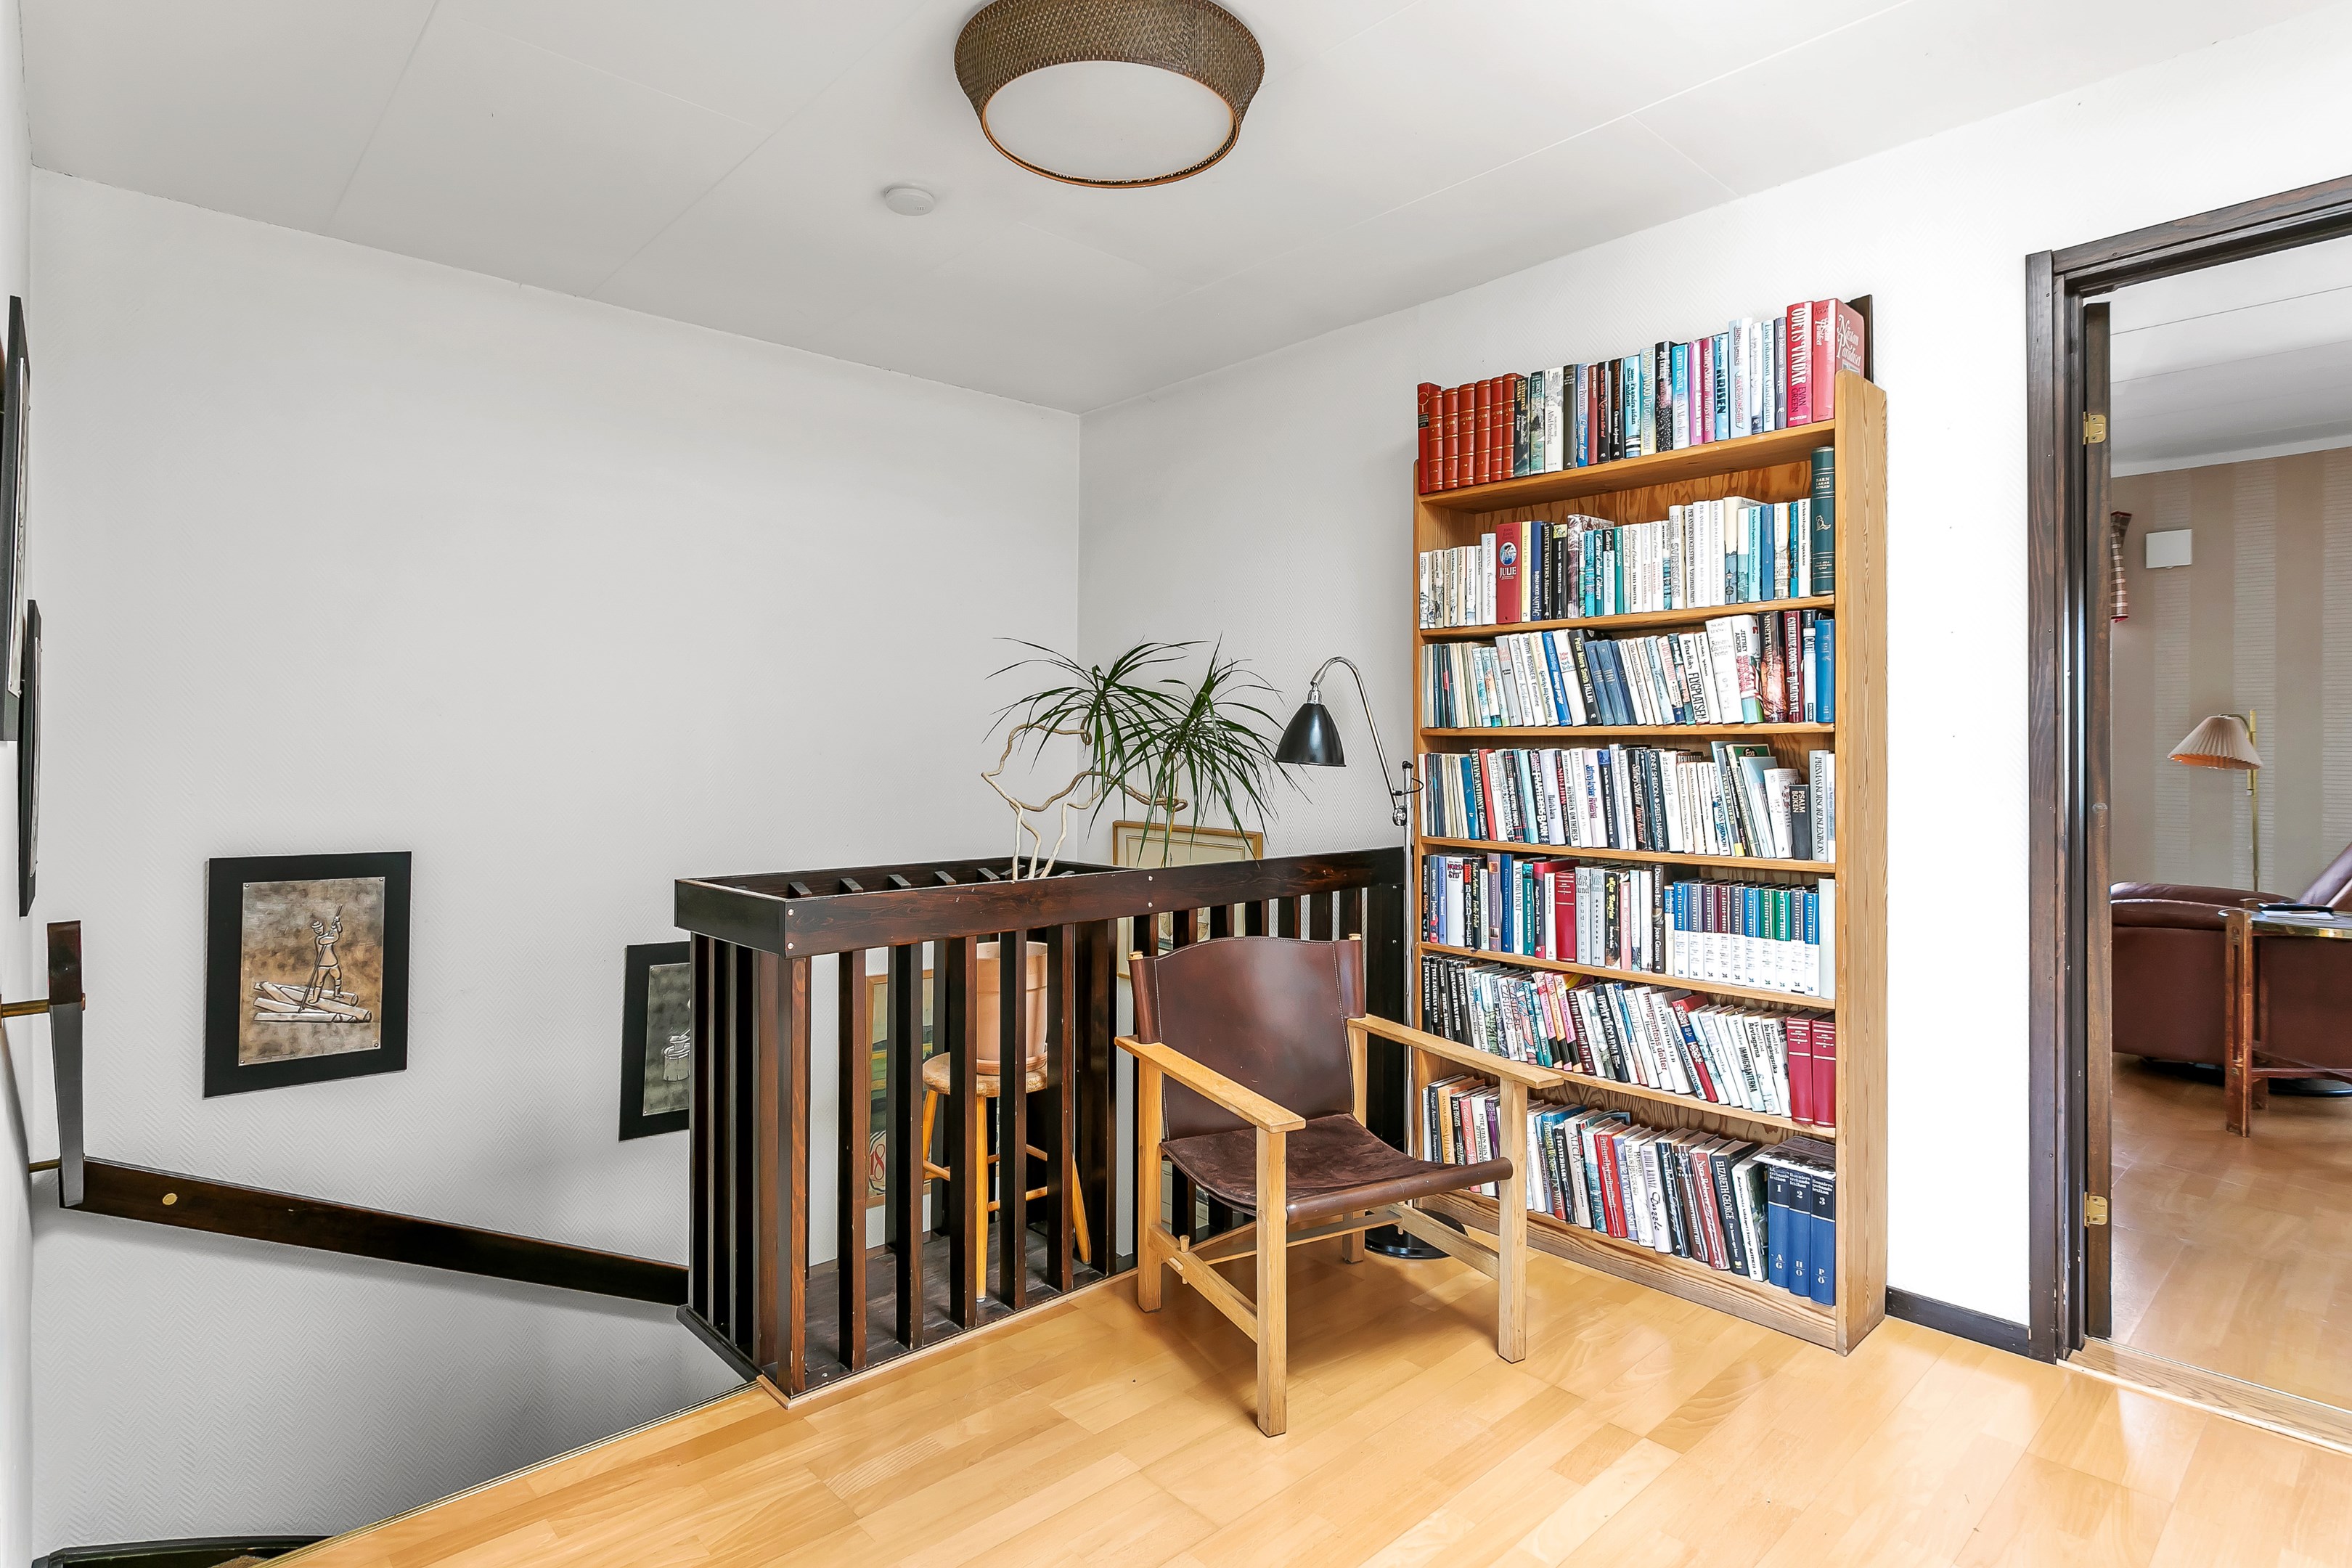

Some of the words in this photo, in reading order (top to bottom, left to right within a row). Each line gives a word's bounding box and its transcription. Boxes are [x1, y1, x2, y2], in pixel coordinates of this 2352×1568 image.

[1791, 308, 1806, 342] ODETS
[1791, 342, 1806, 386] VINDAR
[1643, 377, 1653, 396] WOOD
[1716, 369, 1726, 415] KRISEN
[1500, 567, 1516, 578] JULIE
[1671, 542, 1680, 597] SVENSSONS
[1763, 615, 1772, 645] MINETTE
[1526, 656, 1535, 680] ROSSNER
[1531, 682, 1540, 707] Emmeline
[1689, 672, 1707, 719] FLYGPLATSEN
[1471, 754, 1480, 777] EVELYN
[1474, 779, 1484, 810] ANTHONY
[1537, 815, 1548, 836] BARN
[1643, 992, 1662, 1046] Immigrantens
[1657, 1048, 1667, 1071] dotter
[1748, 1023, 1760, 1058] Arvtagarna
[1677, 1039, 1690, 1066] VREDENS
[1687, 1066, 1699, 1091] DRUVOR
[1739, 1047, 1757, 1093] IMMIGRANTERNA
[1547, 1149, 1556, 1171] WOOD
[1570, 1132, 1580, 1164] ALICIA
[1551, 1178, 1561, 1210] DOMINA
[1715, 1161, 1729, 1193] ELIZABETH
[1723, 1194, 1735, 1220] GEORGE
